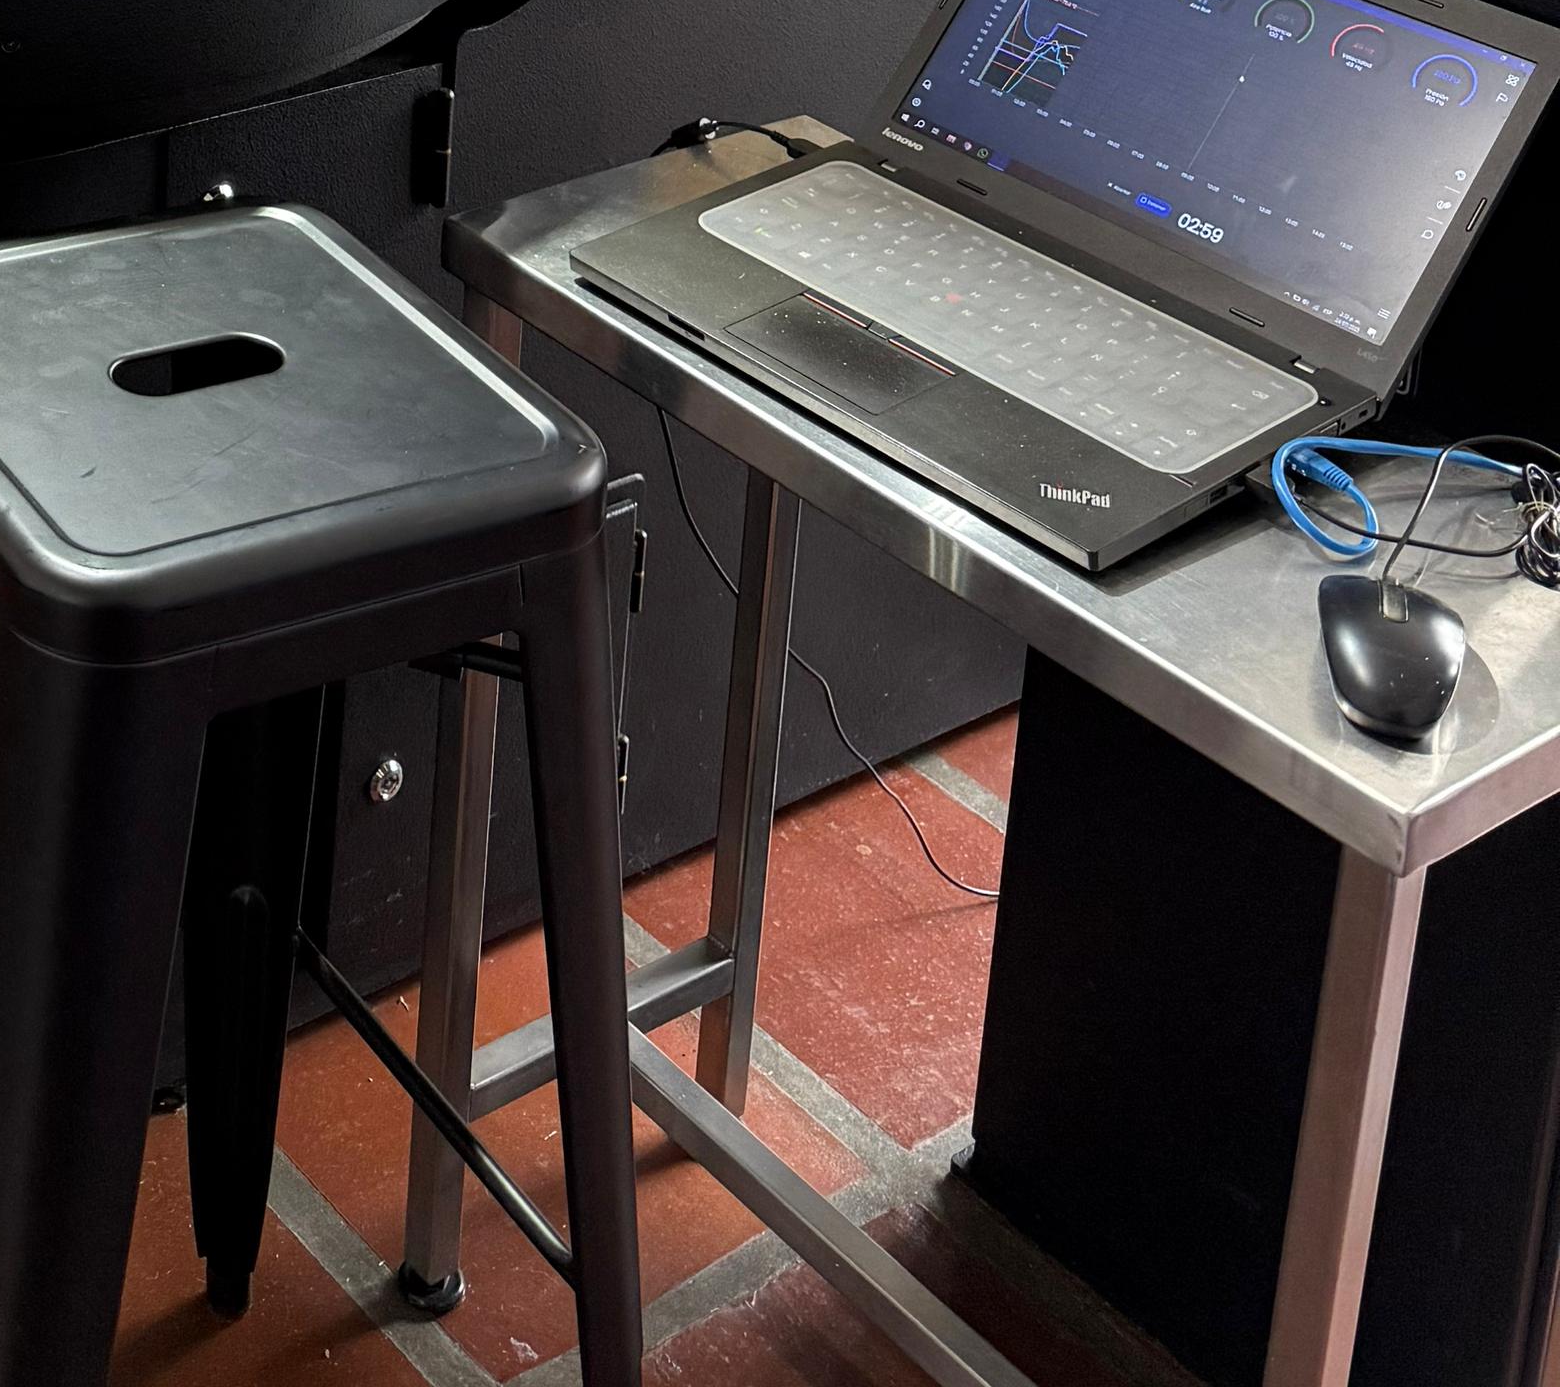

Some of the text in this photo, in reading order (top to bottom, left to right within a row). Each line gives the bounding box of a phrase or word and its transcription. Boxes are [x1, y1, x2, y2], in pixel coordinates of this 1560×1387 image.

[882, 127, 924, 151] lenovo
[1177, 213, 1224, 244] 02:59
[1039, 482, 1110, 508] ThinkPad
